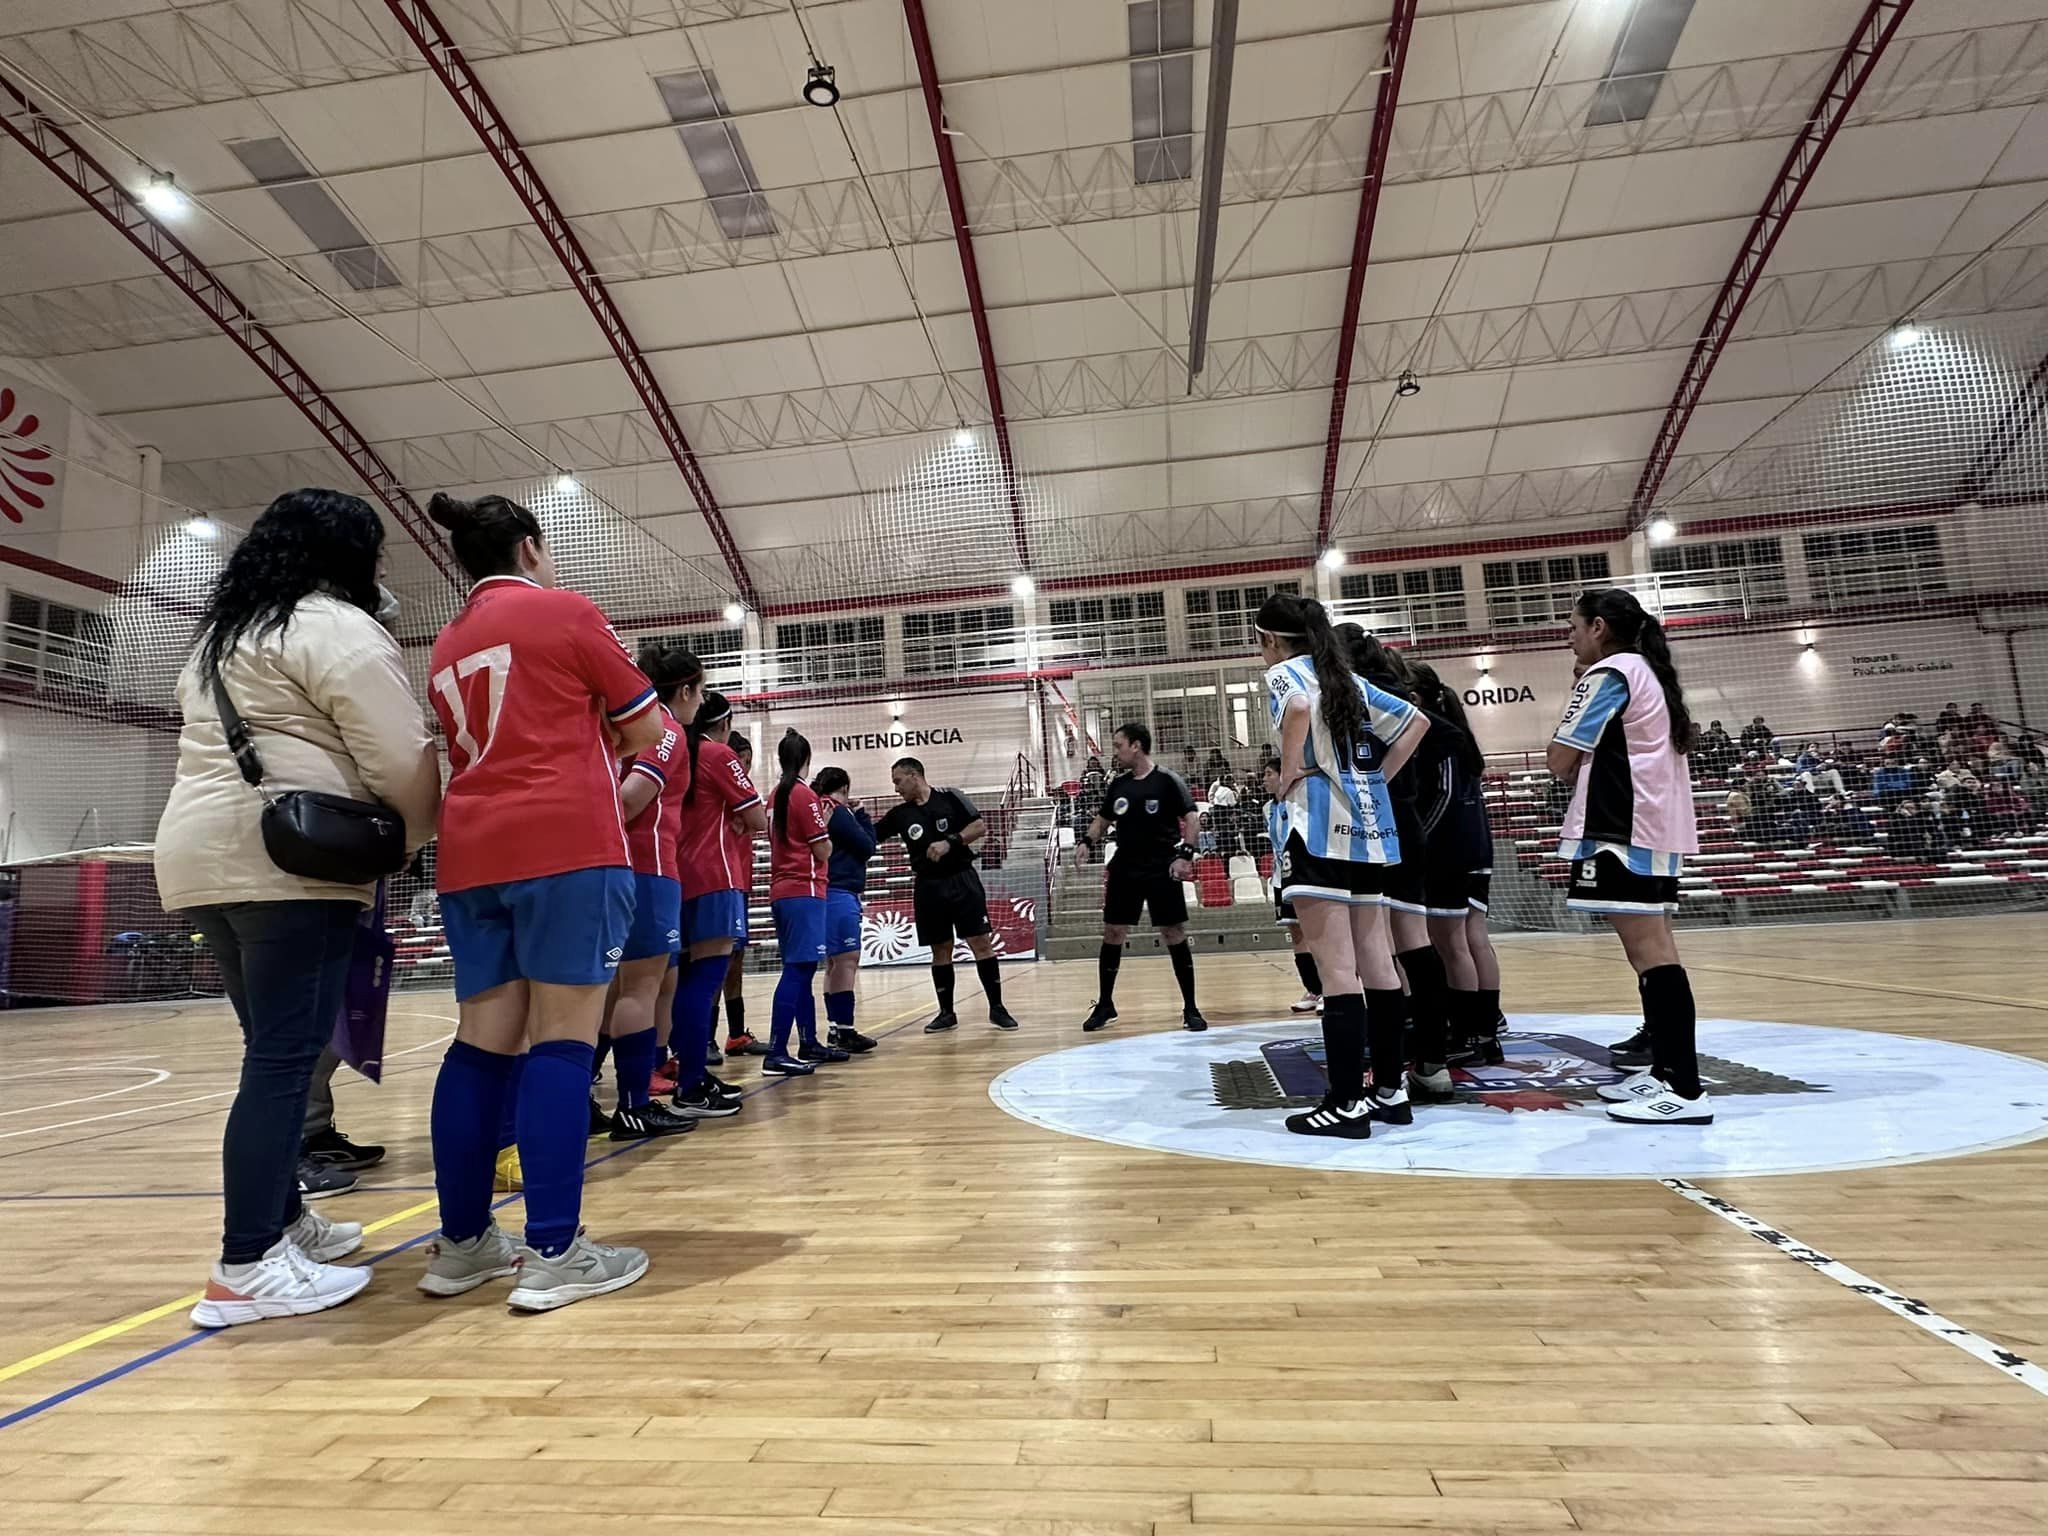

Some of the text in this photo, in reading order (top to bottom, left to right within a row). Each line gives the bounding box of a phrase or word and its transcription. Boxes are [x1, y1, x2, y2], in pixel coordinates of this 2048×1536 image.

[432, 643, 512, 772] 17
[1462, 685, 1536, 706] ORIDA
[656, 728, 678, 762] antel
[831, 727, 964, 753] INTENDENCIA
[726, 759, 752, 790] antel
[1582, 859, 1597, 880] 5
